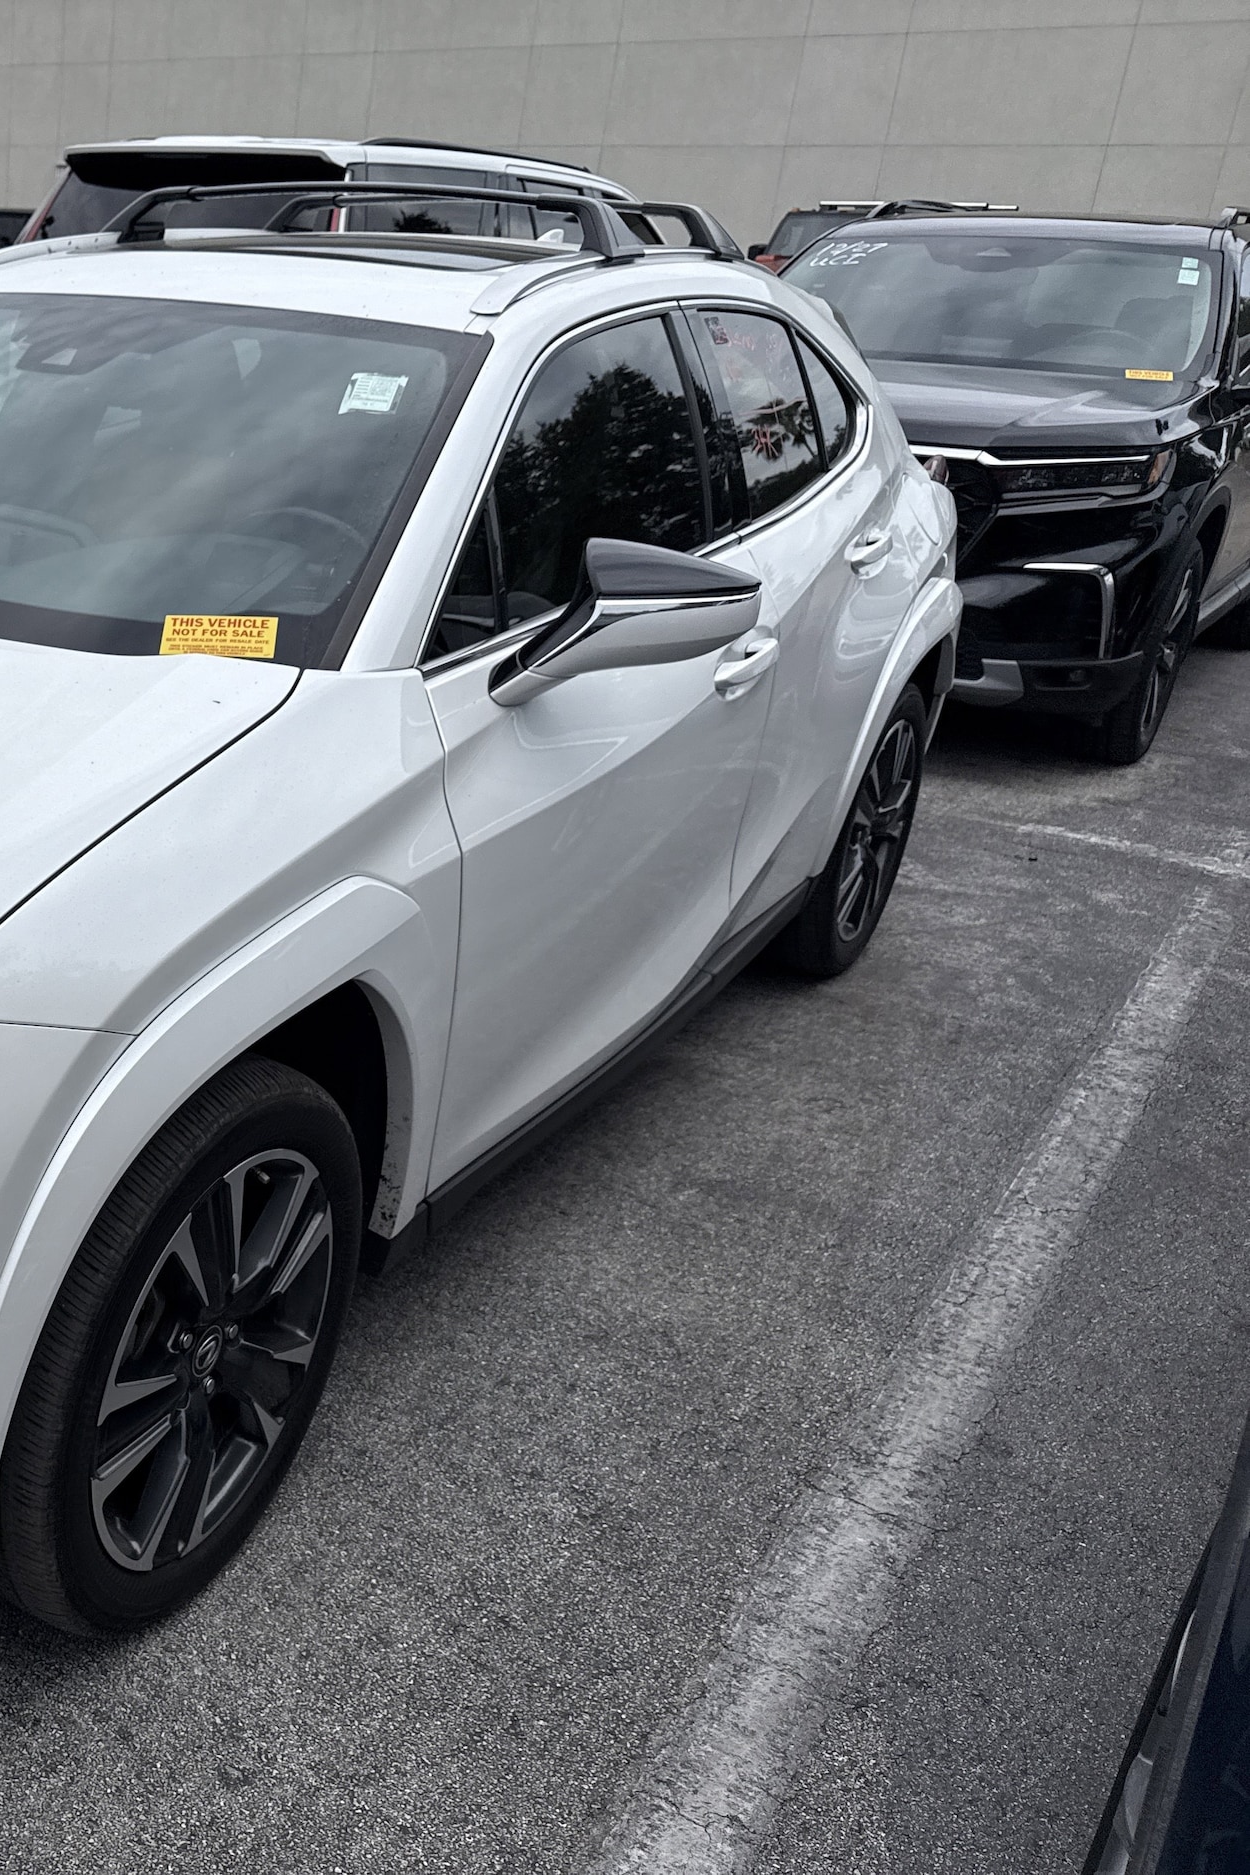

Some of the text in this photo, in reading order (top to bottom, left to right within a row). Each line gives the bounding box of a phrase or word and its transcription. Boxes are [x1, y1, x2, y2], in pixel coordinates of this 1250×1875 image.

[171, 617, 270, 629] THIS VEHICLE
[171, 628, 265, 638] NOT FOR SALE
